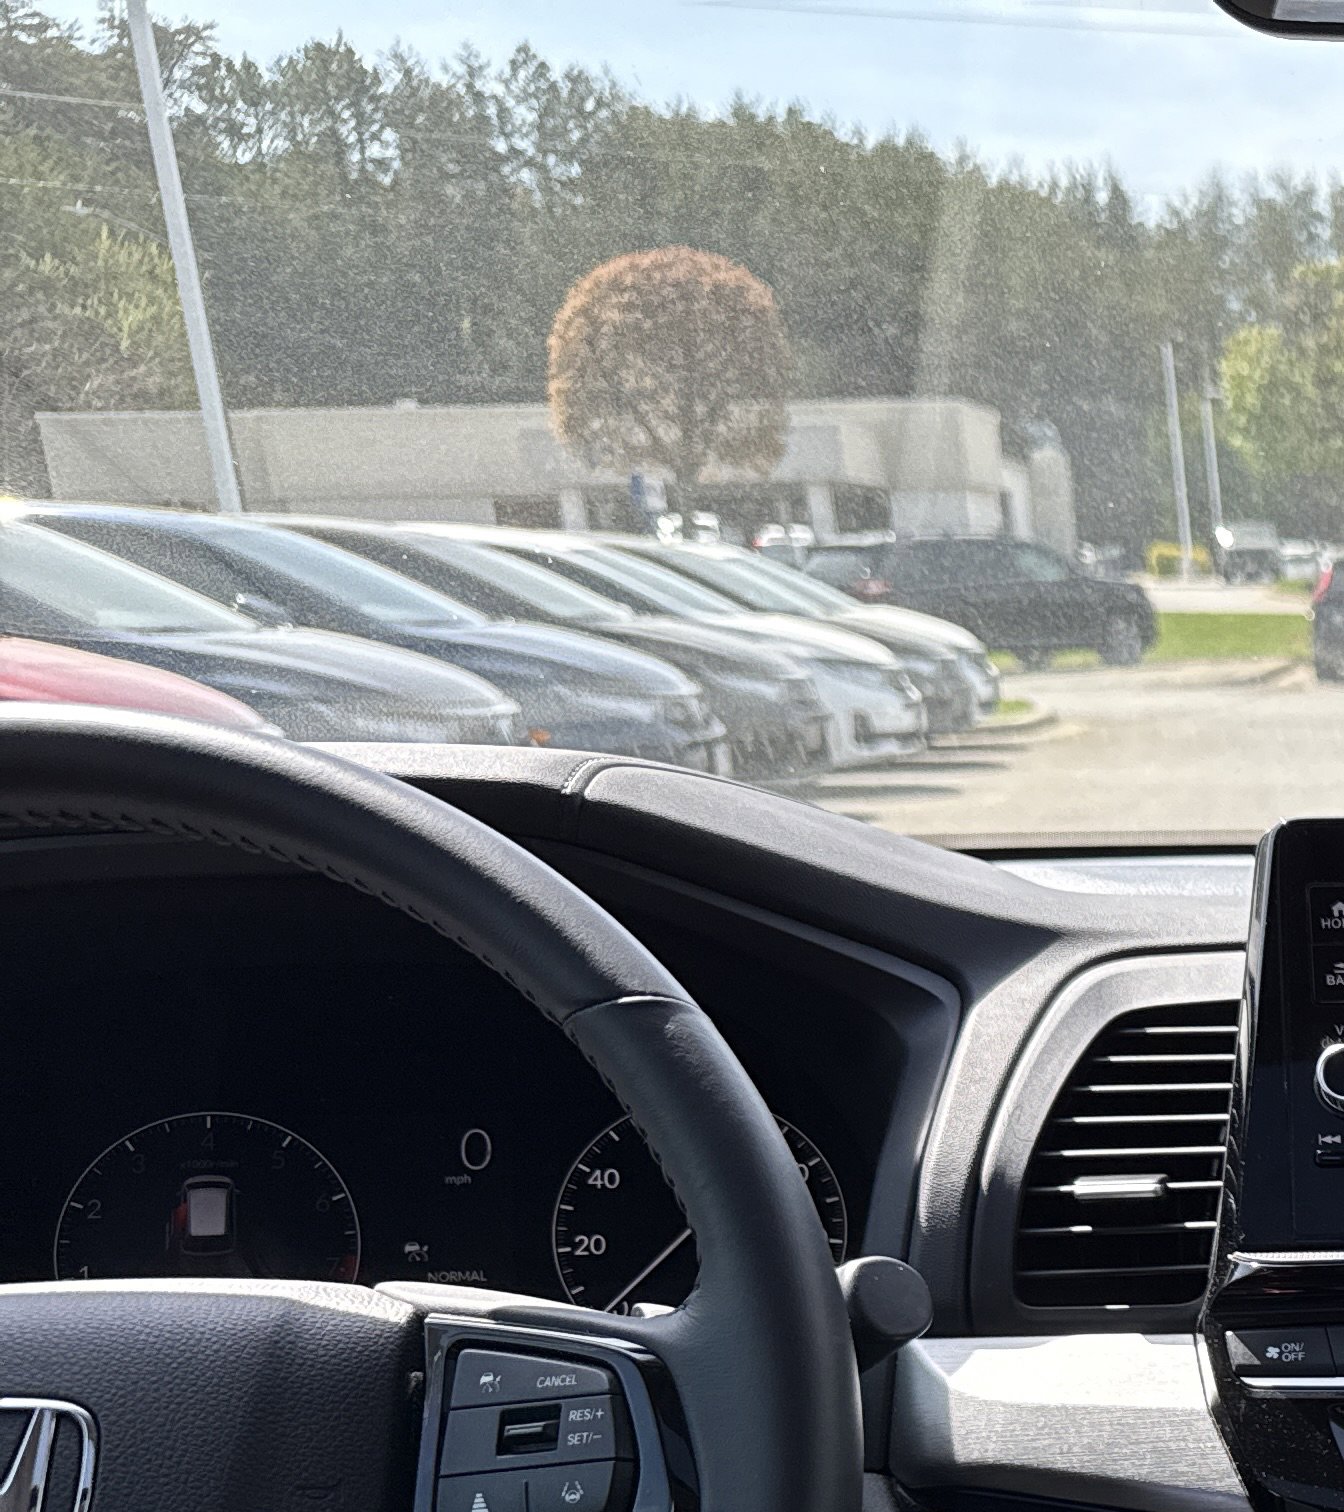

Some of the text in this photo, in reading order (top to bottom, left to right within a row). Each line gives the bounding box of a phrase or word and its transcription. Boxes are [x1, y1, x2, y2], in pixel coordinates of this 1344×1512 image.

[461, 1128, 492, 1171] 0
[445, 1174, 472, 1186] mph
[587, 1168, 621, 1189] 40
[86, 1200, 101, 1219] 2
[574, 1234, 606, 1256] 20
[427, 1270, 487, 1283] NORMAL
[1282, 1342, 1305, 1352] ON/
[1282, 1351, 1306, 1362] OFF
[536, 1374, 578, 1388] CANCEL
